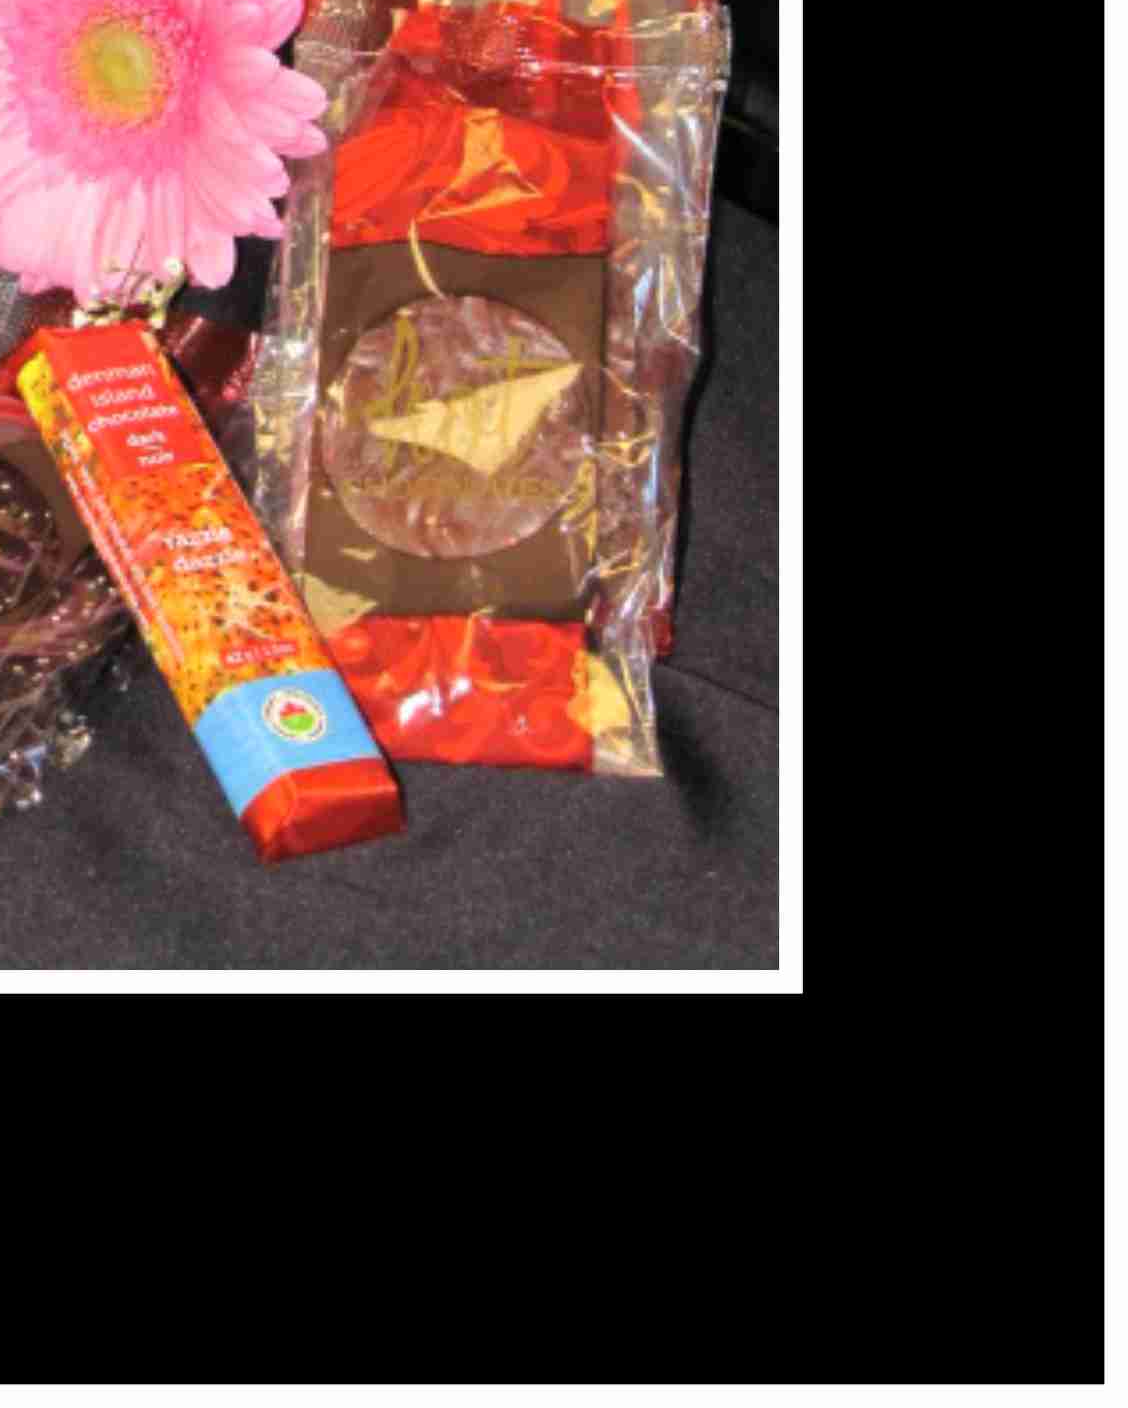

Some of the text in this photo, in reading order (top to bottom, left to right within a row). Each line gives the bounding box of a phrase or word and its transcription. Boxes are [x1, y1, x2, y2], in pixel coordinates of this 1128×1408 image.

[65, 362, 156, 392] denman
[89, 383, 156, 409] island
[86, 404, 179, 433] chocolate
